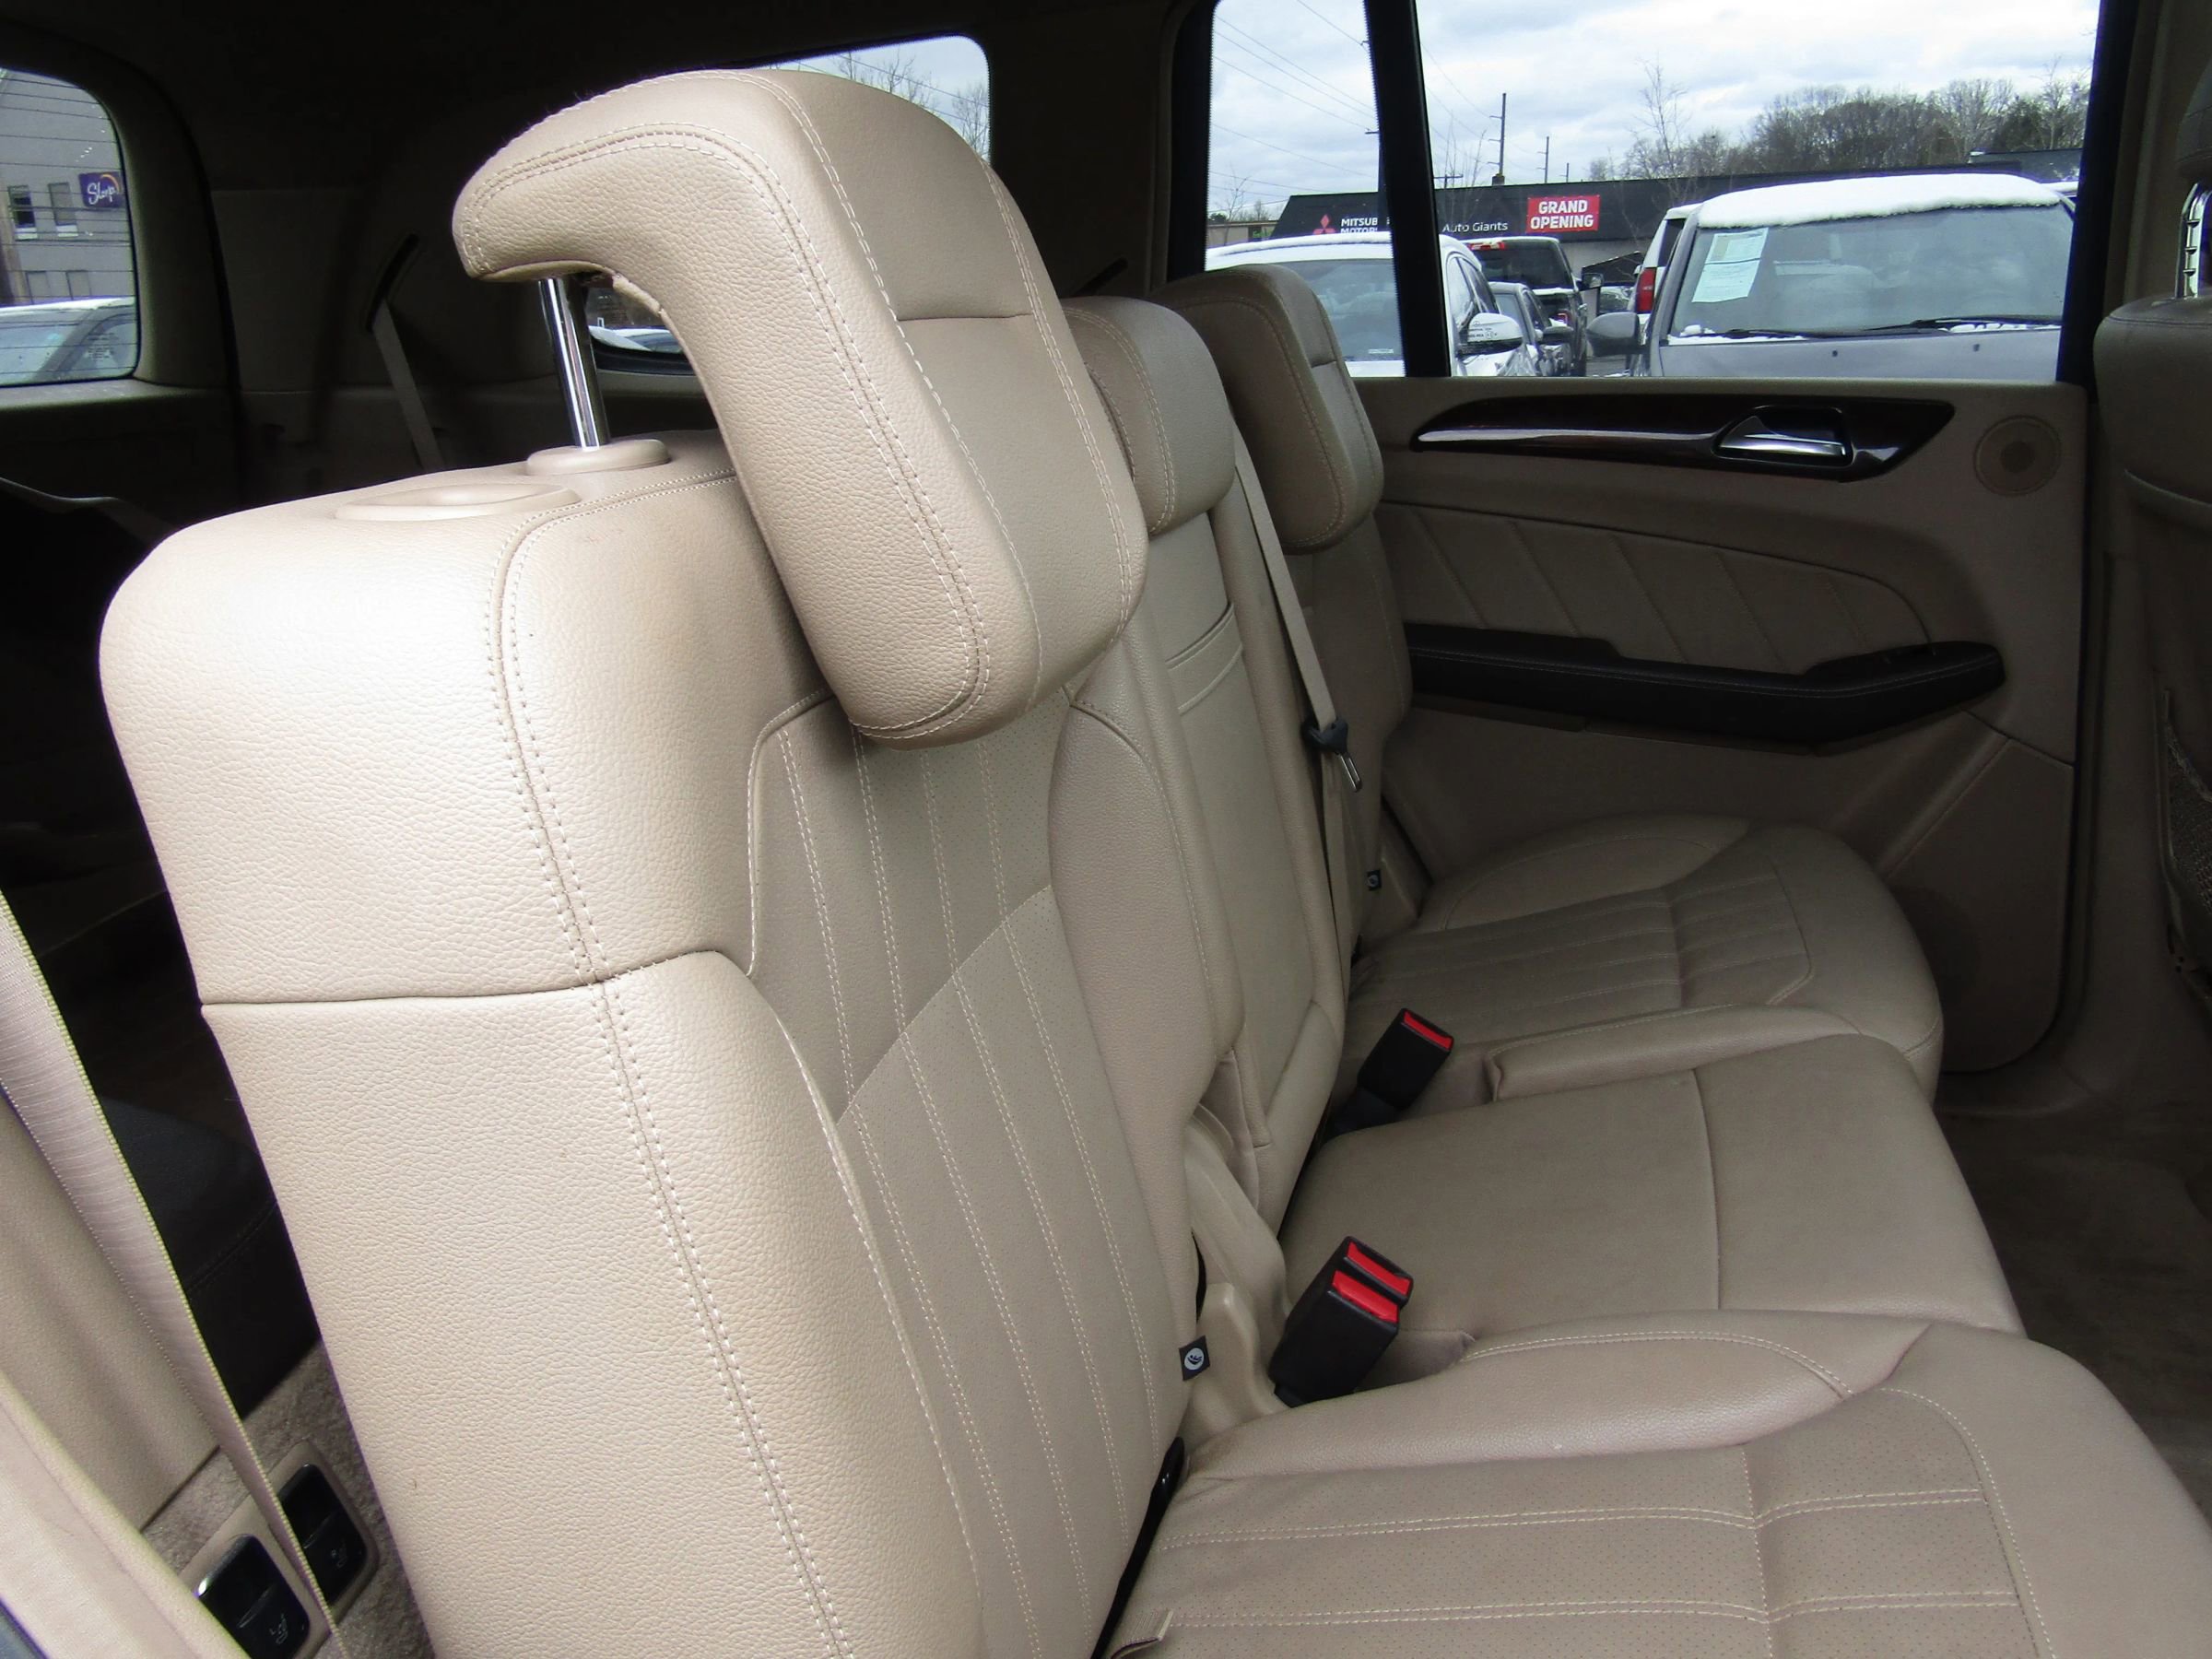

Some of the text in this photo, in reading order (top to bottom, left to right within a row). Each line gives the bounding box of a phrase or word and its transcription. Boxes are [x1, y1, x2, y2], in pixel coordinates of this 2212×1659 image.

[1538, 200, 1588, 215] GRAND
[1341, 218, 1389, 227] MITSUB
[1442, 222, 1509, 232] Auto Giants
[1530, 215, 1594, 229] OPENING
